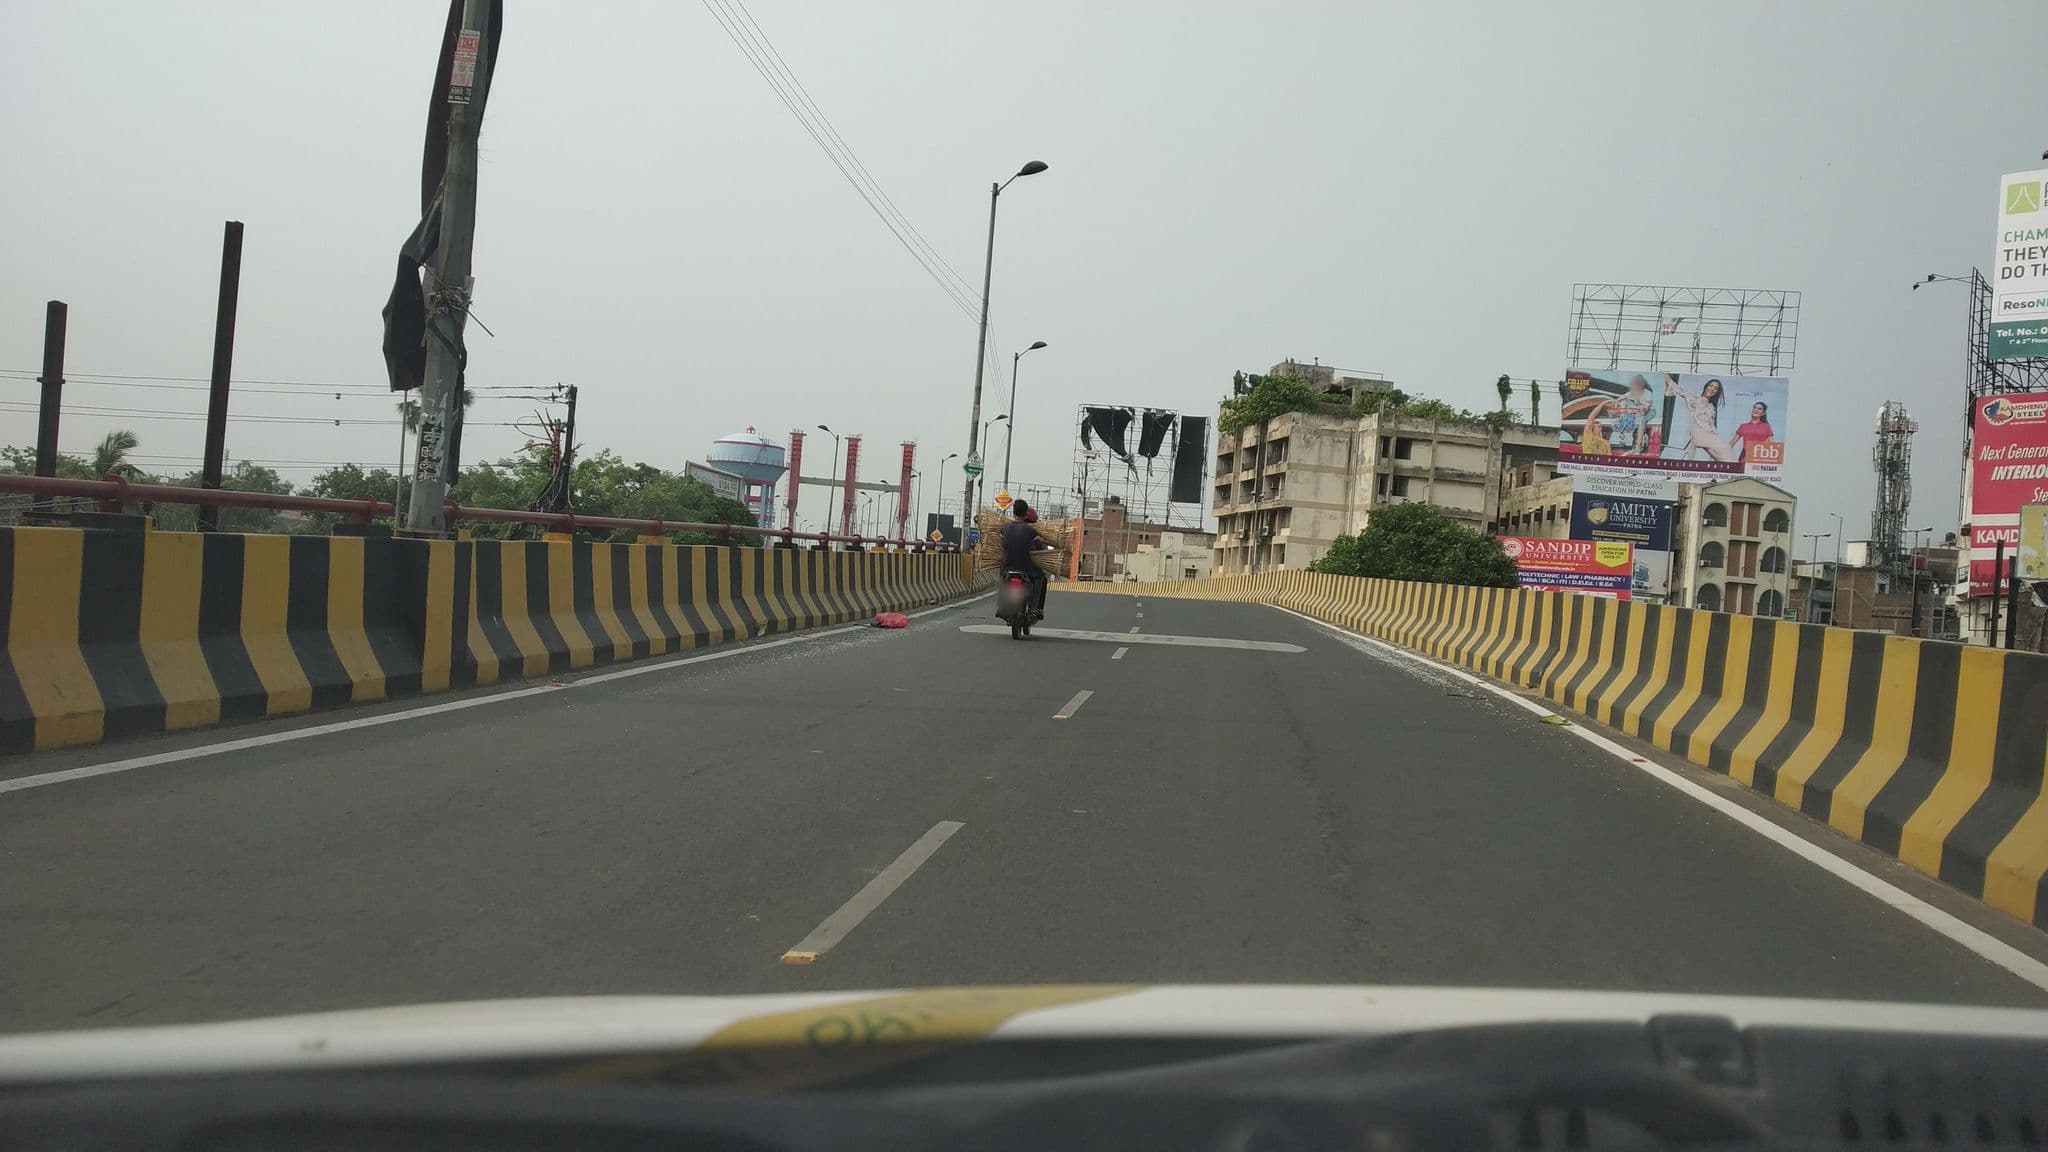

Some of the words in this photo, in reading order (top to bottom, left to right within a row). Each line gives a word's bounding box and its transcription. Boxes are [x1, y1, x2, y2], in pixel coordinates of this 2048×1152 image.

[2003, 246, 2048, 262] THEY
[2001, 265, 2025, 280] DO
[1996, 328, 2014, 337] Tel.
[1567, 378, 1591, 386] COLLEGE
[2000, 403, 2047, 411] KAMDHENU
[1753, 444, 1779, 459] fbb
[1980, 445, 2006, 460] Next
[1586, 476, 1617, 485] DISCOVER
[1592, 484, 1626, 494] EDUCATION
[1635, 488, 1657, 496] PATNA
[1610, 502, 1659, 517] AMITY
[1609, 514, 1658, 525] UNIVERSITY
[1976, 529, 2019, 544] KAMD
[1526, 540, 1592, 554] SANDIP
[1526, 552, 1591, 562] UNIVERSITY
